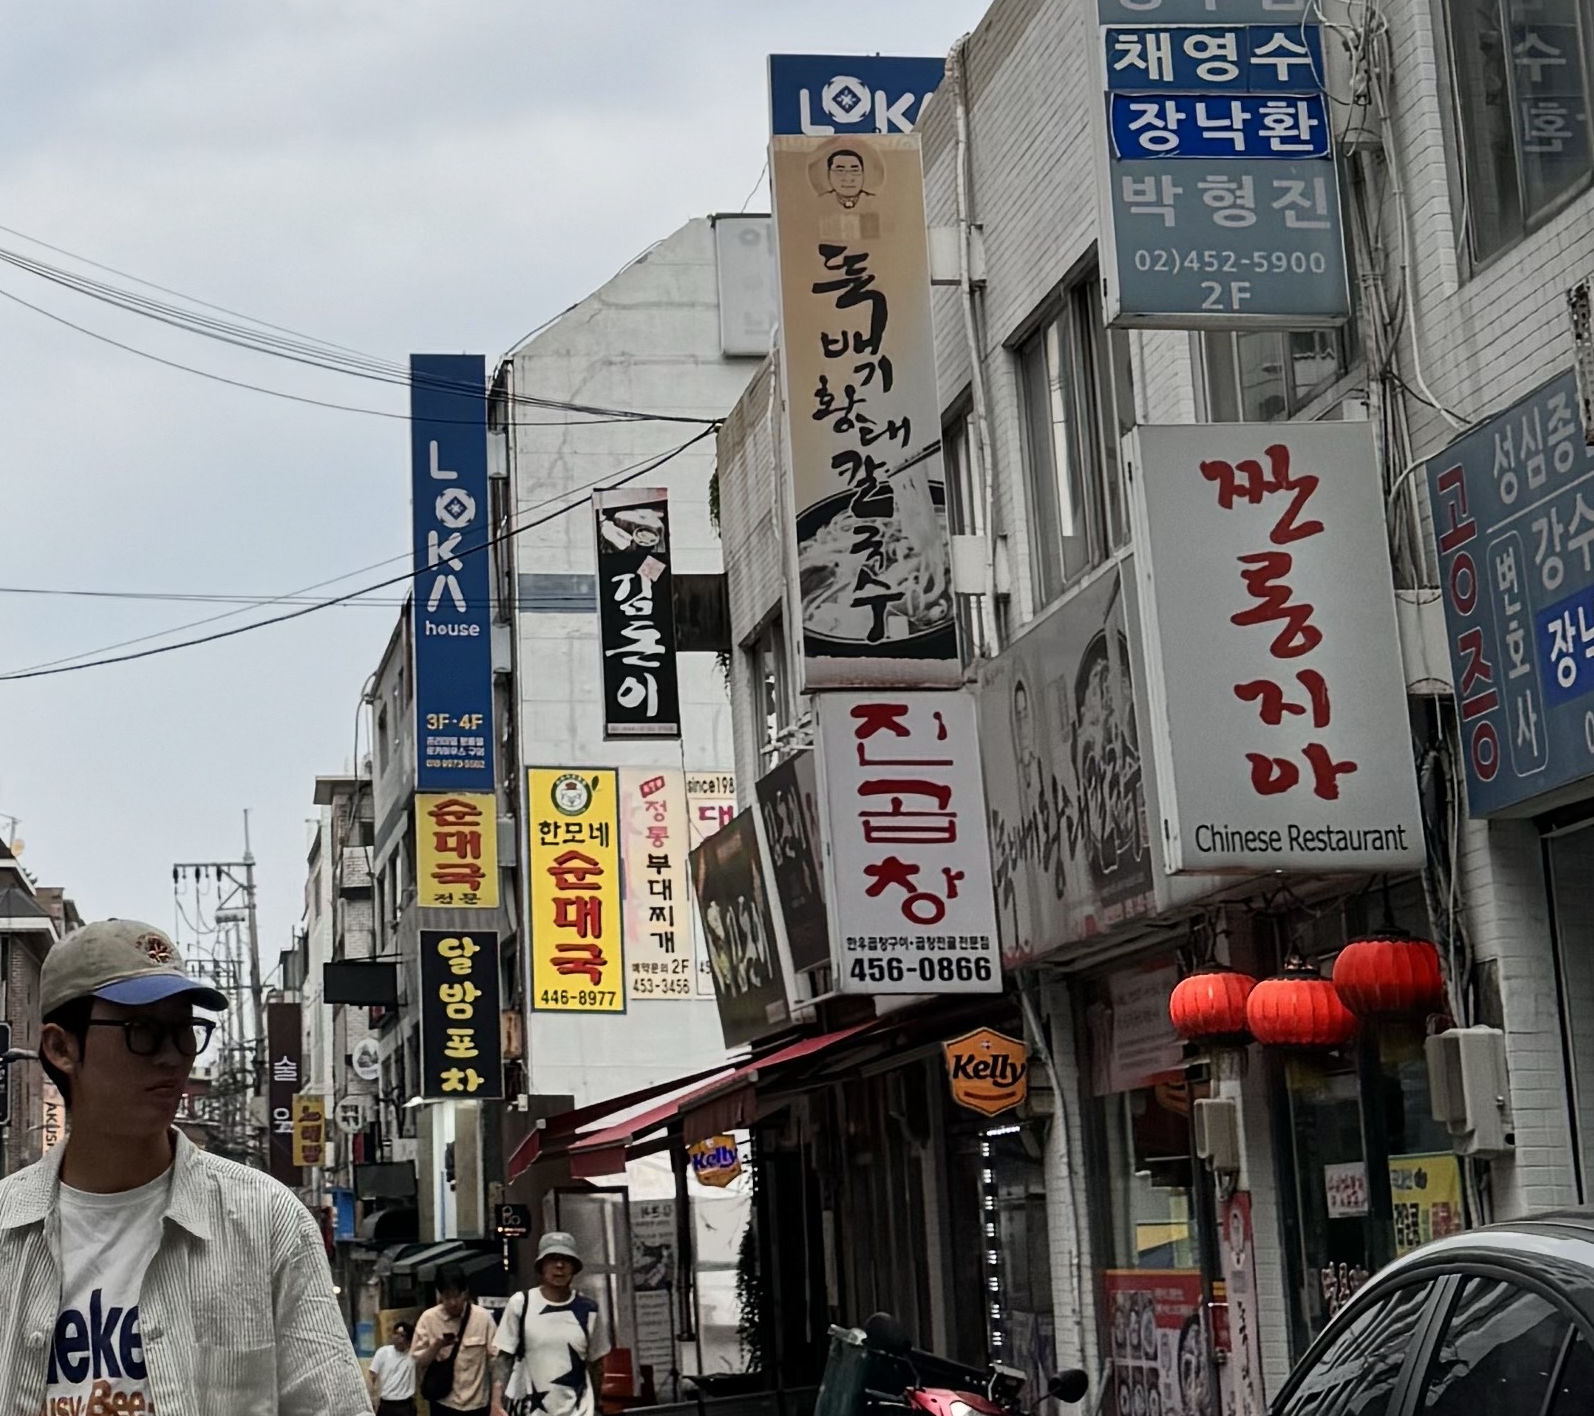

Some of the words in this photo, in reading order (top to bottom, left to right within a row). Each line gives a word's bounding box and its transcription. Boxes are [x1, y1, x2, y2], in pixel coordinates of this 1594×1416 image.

[1112, 31, 1312, 82] 채영수
[1128, 99, 1319, 153] 장낙환
[1122, 174, 1331, 229] 박형진
[1135, 248, 1326, 274] 02)452-5900
[1201, 281, 1252, 310] 2F
[1493, 391, 1594, 504] 성심종
[425, 621, 480, 638] house
[1438, 463, 1501, 781] 공증
[1496, 546, 1538, 757] 변호사
[539, 820, 609, 847] 한모네
[645, 800, 669, 848] 정통
[850, 703, 965, 925] 진곱창
[1195, 824, 1282, 853] Chinese
[1288, 825, 1408, 852] Restaurant
[427, 797, 485, 892] 순대국
[433, 893, 482, 905] 전문
[547, 850, 607, 986] 순대국
[647, 854, 675, 953] 부대찌개
[672, 959, 689, 974] 2F
[850, 956, 992, 982] 456-0866
[437, 936, 484, 1092] 달밤포차
[540, 990, 616, 1006] 446-8977
[952, 1054, 1025, 1088] Kelly
[693, 1146, 737, 1171] Kelly
[47, 1288, 147, 1384] eke
